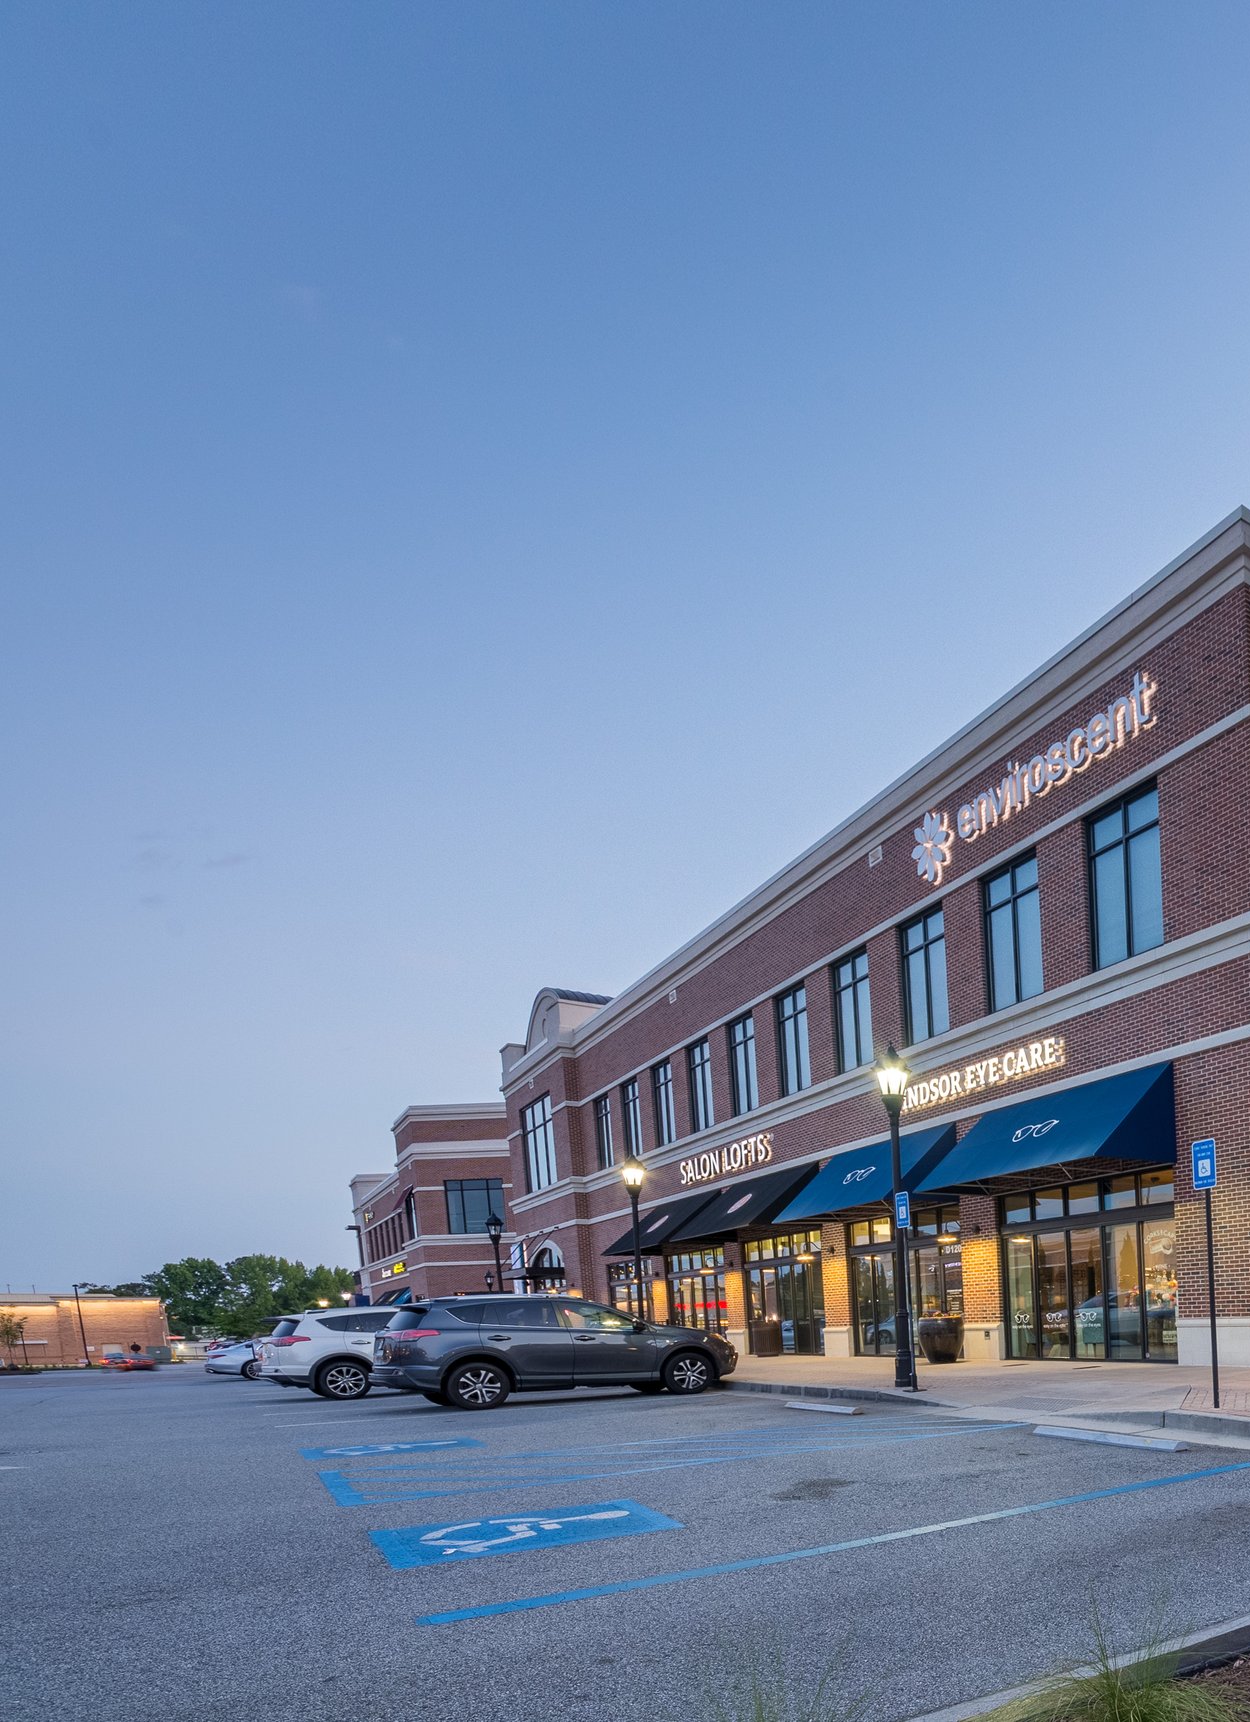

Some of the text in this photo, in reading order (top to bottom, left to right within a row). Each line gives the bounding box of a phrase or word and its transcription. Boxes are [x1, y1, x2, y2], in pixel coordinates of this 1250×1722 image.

[957, 671, 1155, 841] enviroscent
[965, 1057, 1000, 1090] EYE
[1002, 1037, 1058, 1077] CARE
[680, 1150, 720, 1185] SALON
